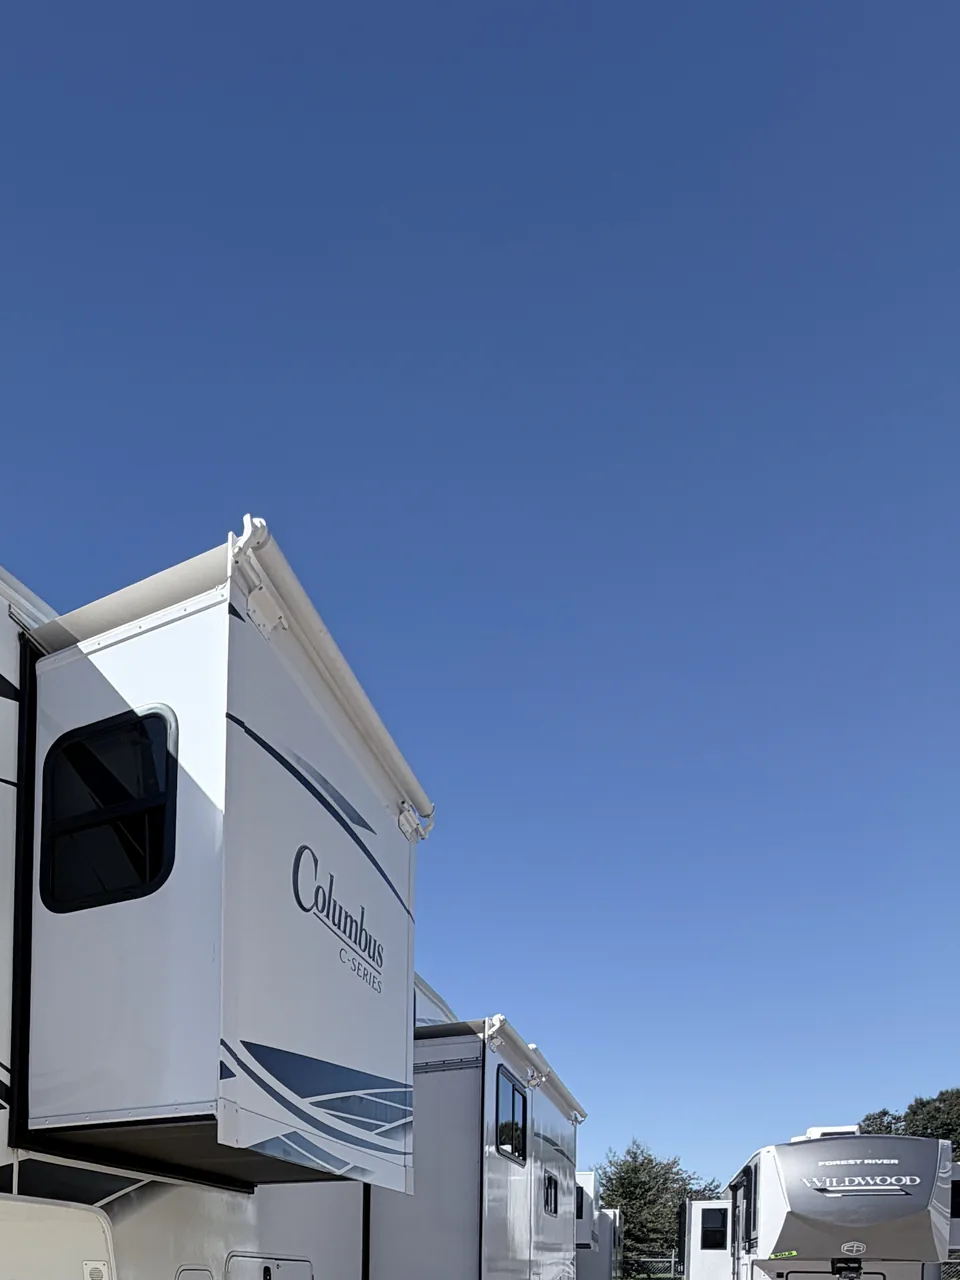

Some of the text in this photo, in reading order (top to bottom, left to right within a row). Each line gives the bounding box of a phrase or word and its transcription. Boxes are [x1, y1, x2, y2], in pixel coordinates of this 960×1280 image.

[292, 845, 384, 968] Columbus
[339, 948, 382, 993] C-SERIES
[801, 1175, 921, 1187] WILDWOOD
